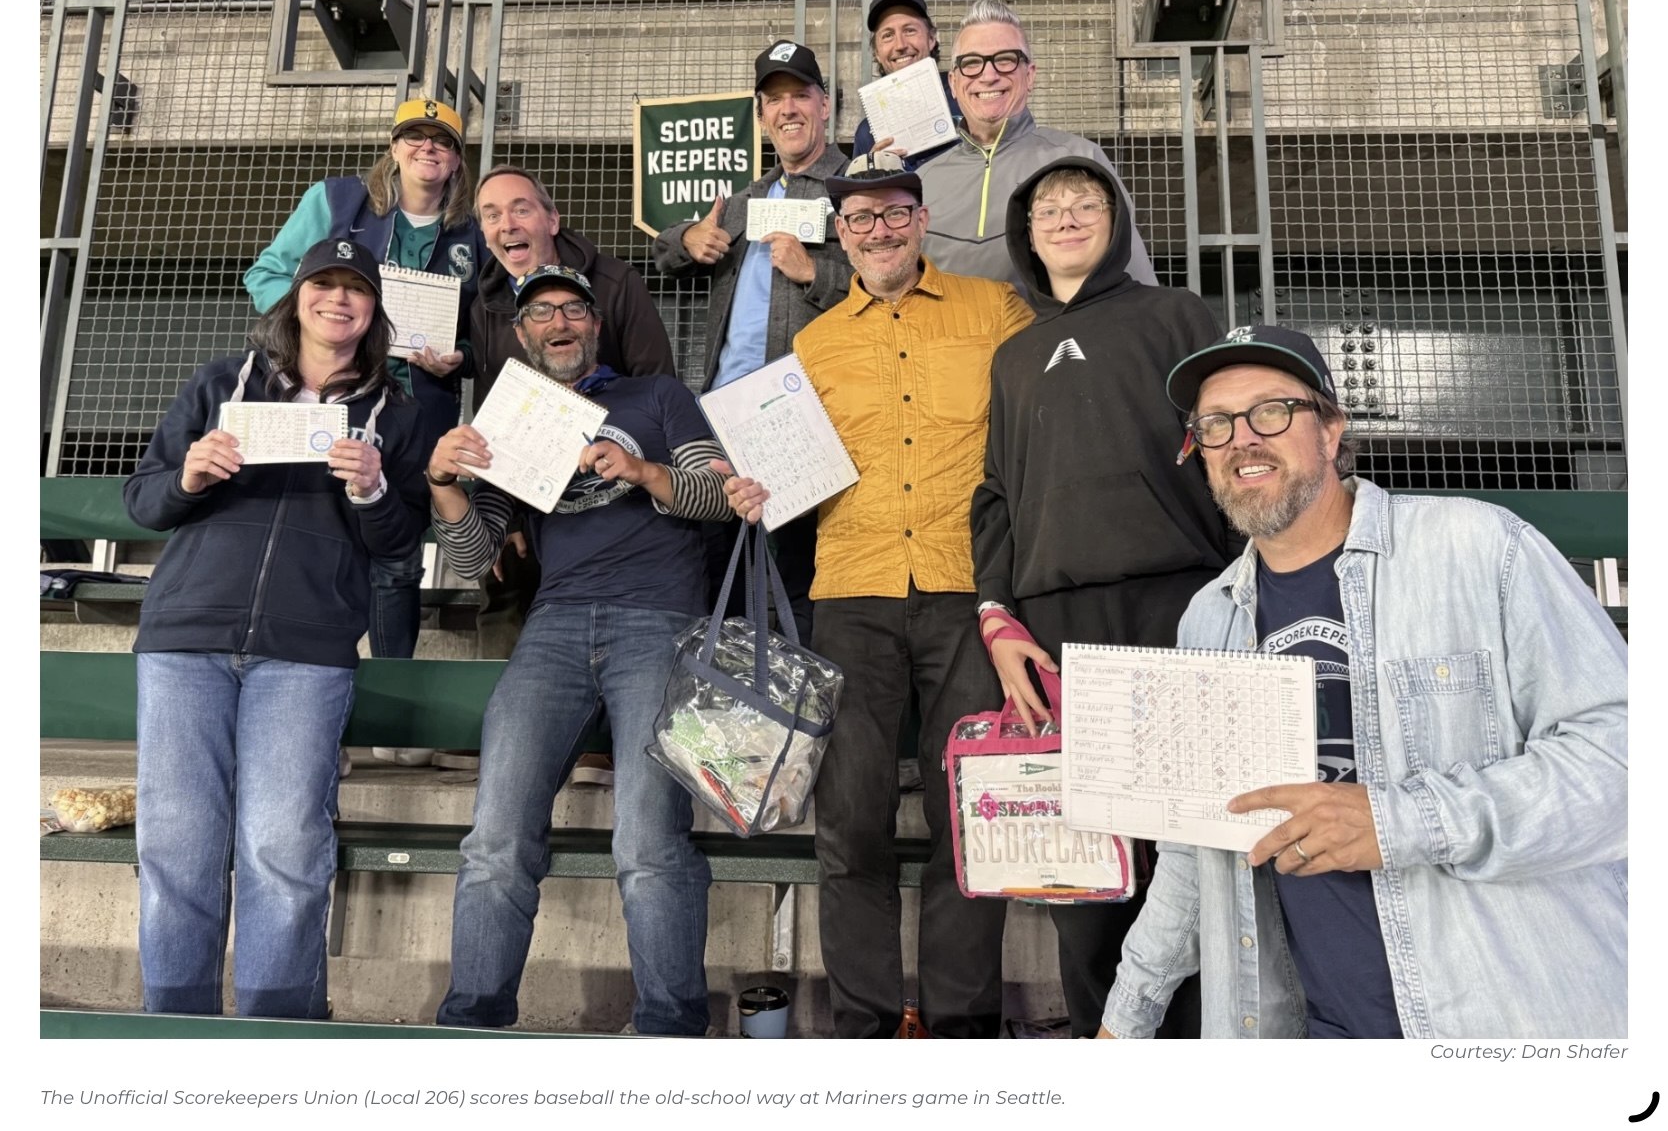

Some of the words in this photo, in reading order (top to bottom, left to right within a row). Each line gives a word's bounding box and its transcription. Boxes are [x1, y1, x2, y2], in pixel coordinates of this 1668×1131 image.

[660, 116, 734, 143] SCORE
[647, 147, 748, 175] KEEPERS
[662, 179, 732, 205] UNION
[615, 434, 638, 455] UNION
[1269, 625, 1349, 651] SCOREKEEPE
